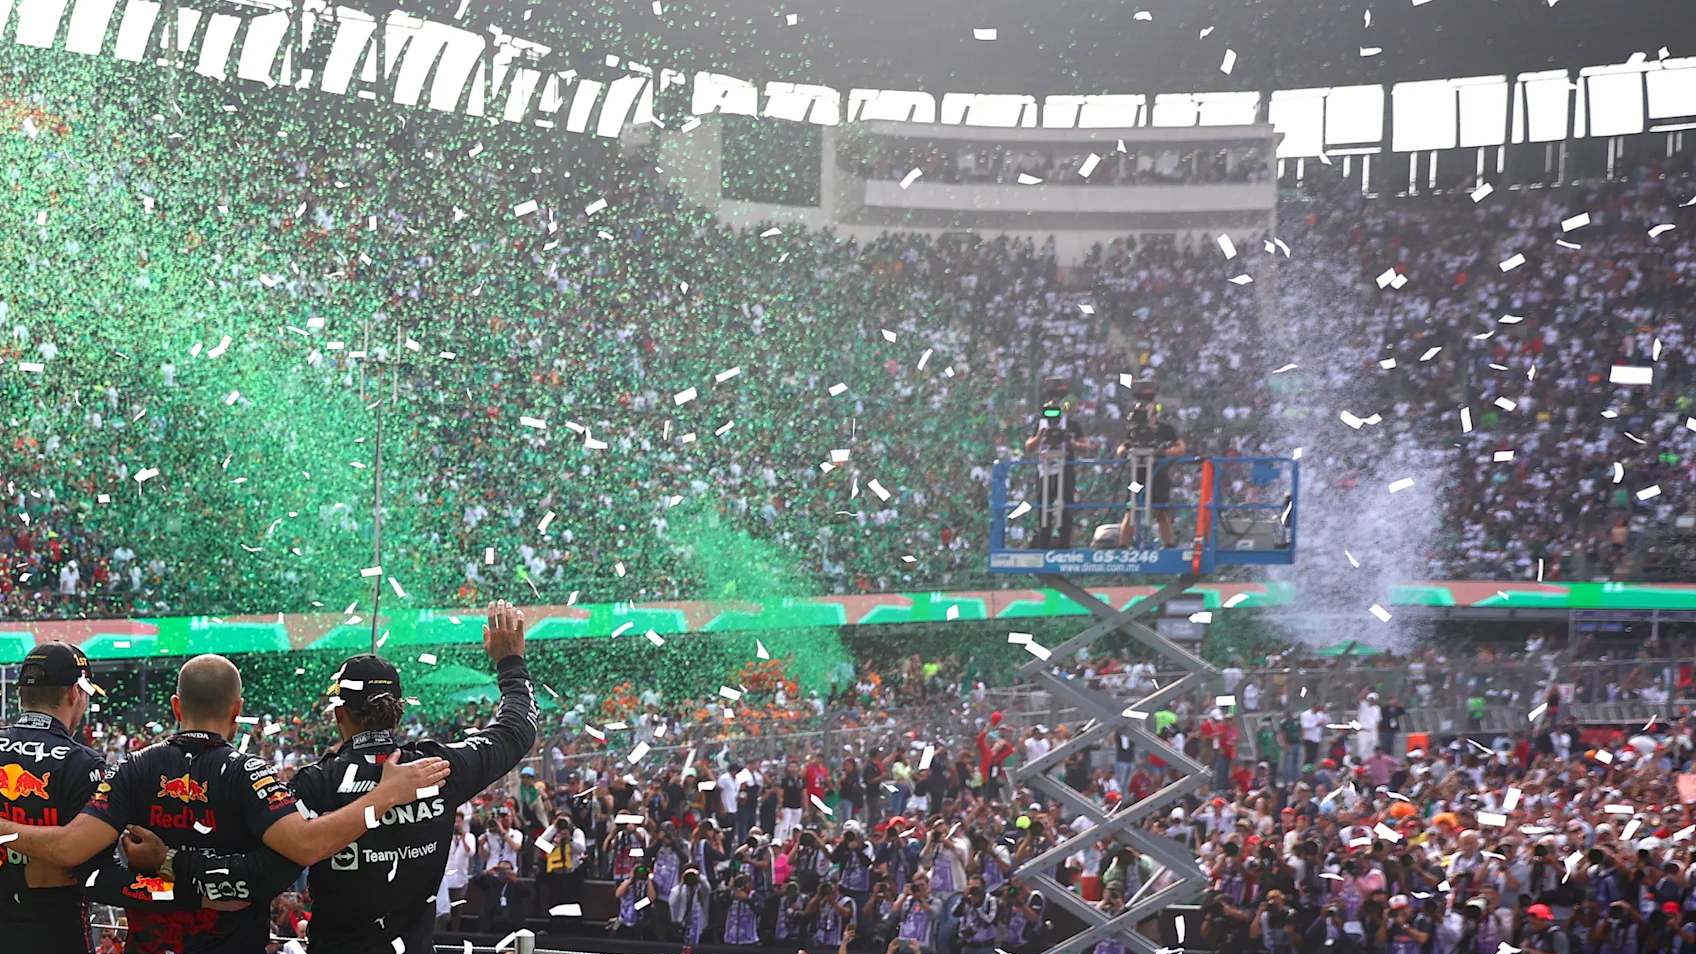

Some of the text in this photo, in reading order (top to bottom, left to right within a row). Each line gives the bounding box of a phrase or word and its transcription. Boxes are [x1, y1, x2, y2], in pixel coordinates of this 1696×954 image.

[1046, 550, 1159, 564] Genie GS-3246
[182, 732, 209, 740] ONDA
[150, 805, 188, 829] Red
[381, 798, 445, 826] ONAS
[362, 841, 437, 863] TeamViewer
